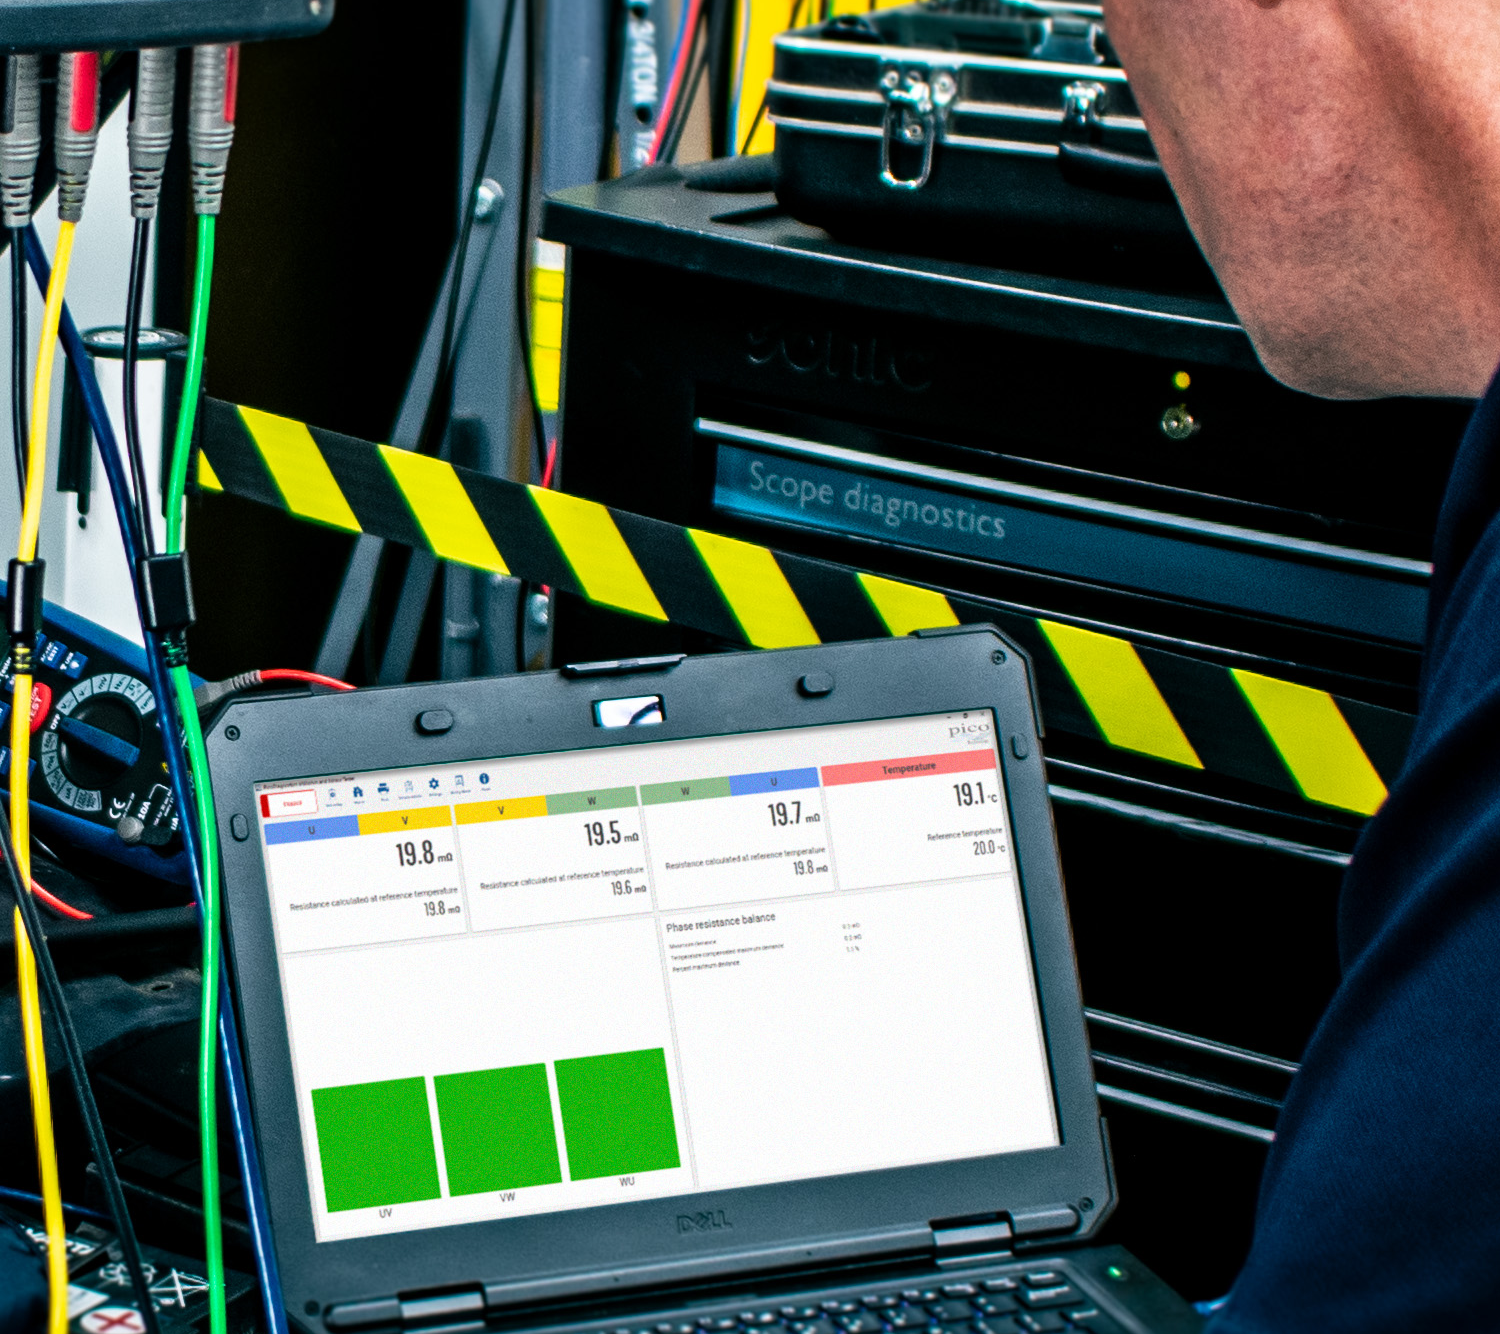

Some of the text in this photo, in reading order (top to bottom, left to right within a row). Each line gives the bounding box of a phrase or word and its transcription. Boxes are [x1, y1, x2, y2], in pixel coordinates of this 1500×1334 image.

[749, 460, 1006, 539] Scope diagnostics
[50, 713, 61, 730] OFF
[949, 723, 990, 738] pico
[883, 762, 936, 774] Temperature
[681, 778, 777, 795] W U
[953, 782, 985, 806] 19.1
[138, 801, 151, 820] 10A
[498, 797, 596, 815] V W
[768, 801, 801, 826] 19.7
[402, 817, 408, 825] V
[584, 821, 621, 846] 19.5
[927, 827, 1002, 841] Reference temperature
[396, 840, 434, 866] 19.8
[973, 840, 995, 855] 20.0
[666, 860, 703, 869] Resistance
[705, 856, 740, 866] calculated
[751, 851, 782, 860] reference
[784, 846, 825, 858] temperature
[793, 860, 814, 875] 19.8
[480, 866, 644, 890] Resistance calculated at reference temperature
[611, 880, 632, 895] 19.6
[290, 886, 458, 911] Resistance calculated at reference temperature
[424, 901, 445, 916] 19.8
[667, 913, 775, 932] Phase resistance balance
[619, 1176, 635, 1187] WU
[500, 1192, 516, 1202] VW
[379, 1208, 393, 1219] UV
[676, 1211, 732, 1234] DELL
